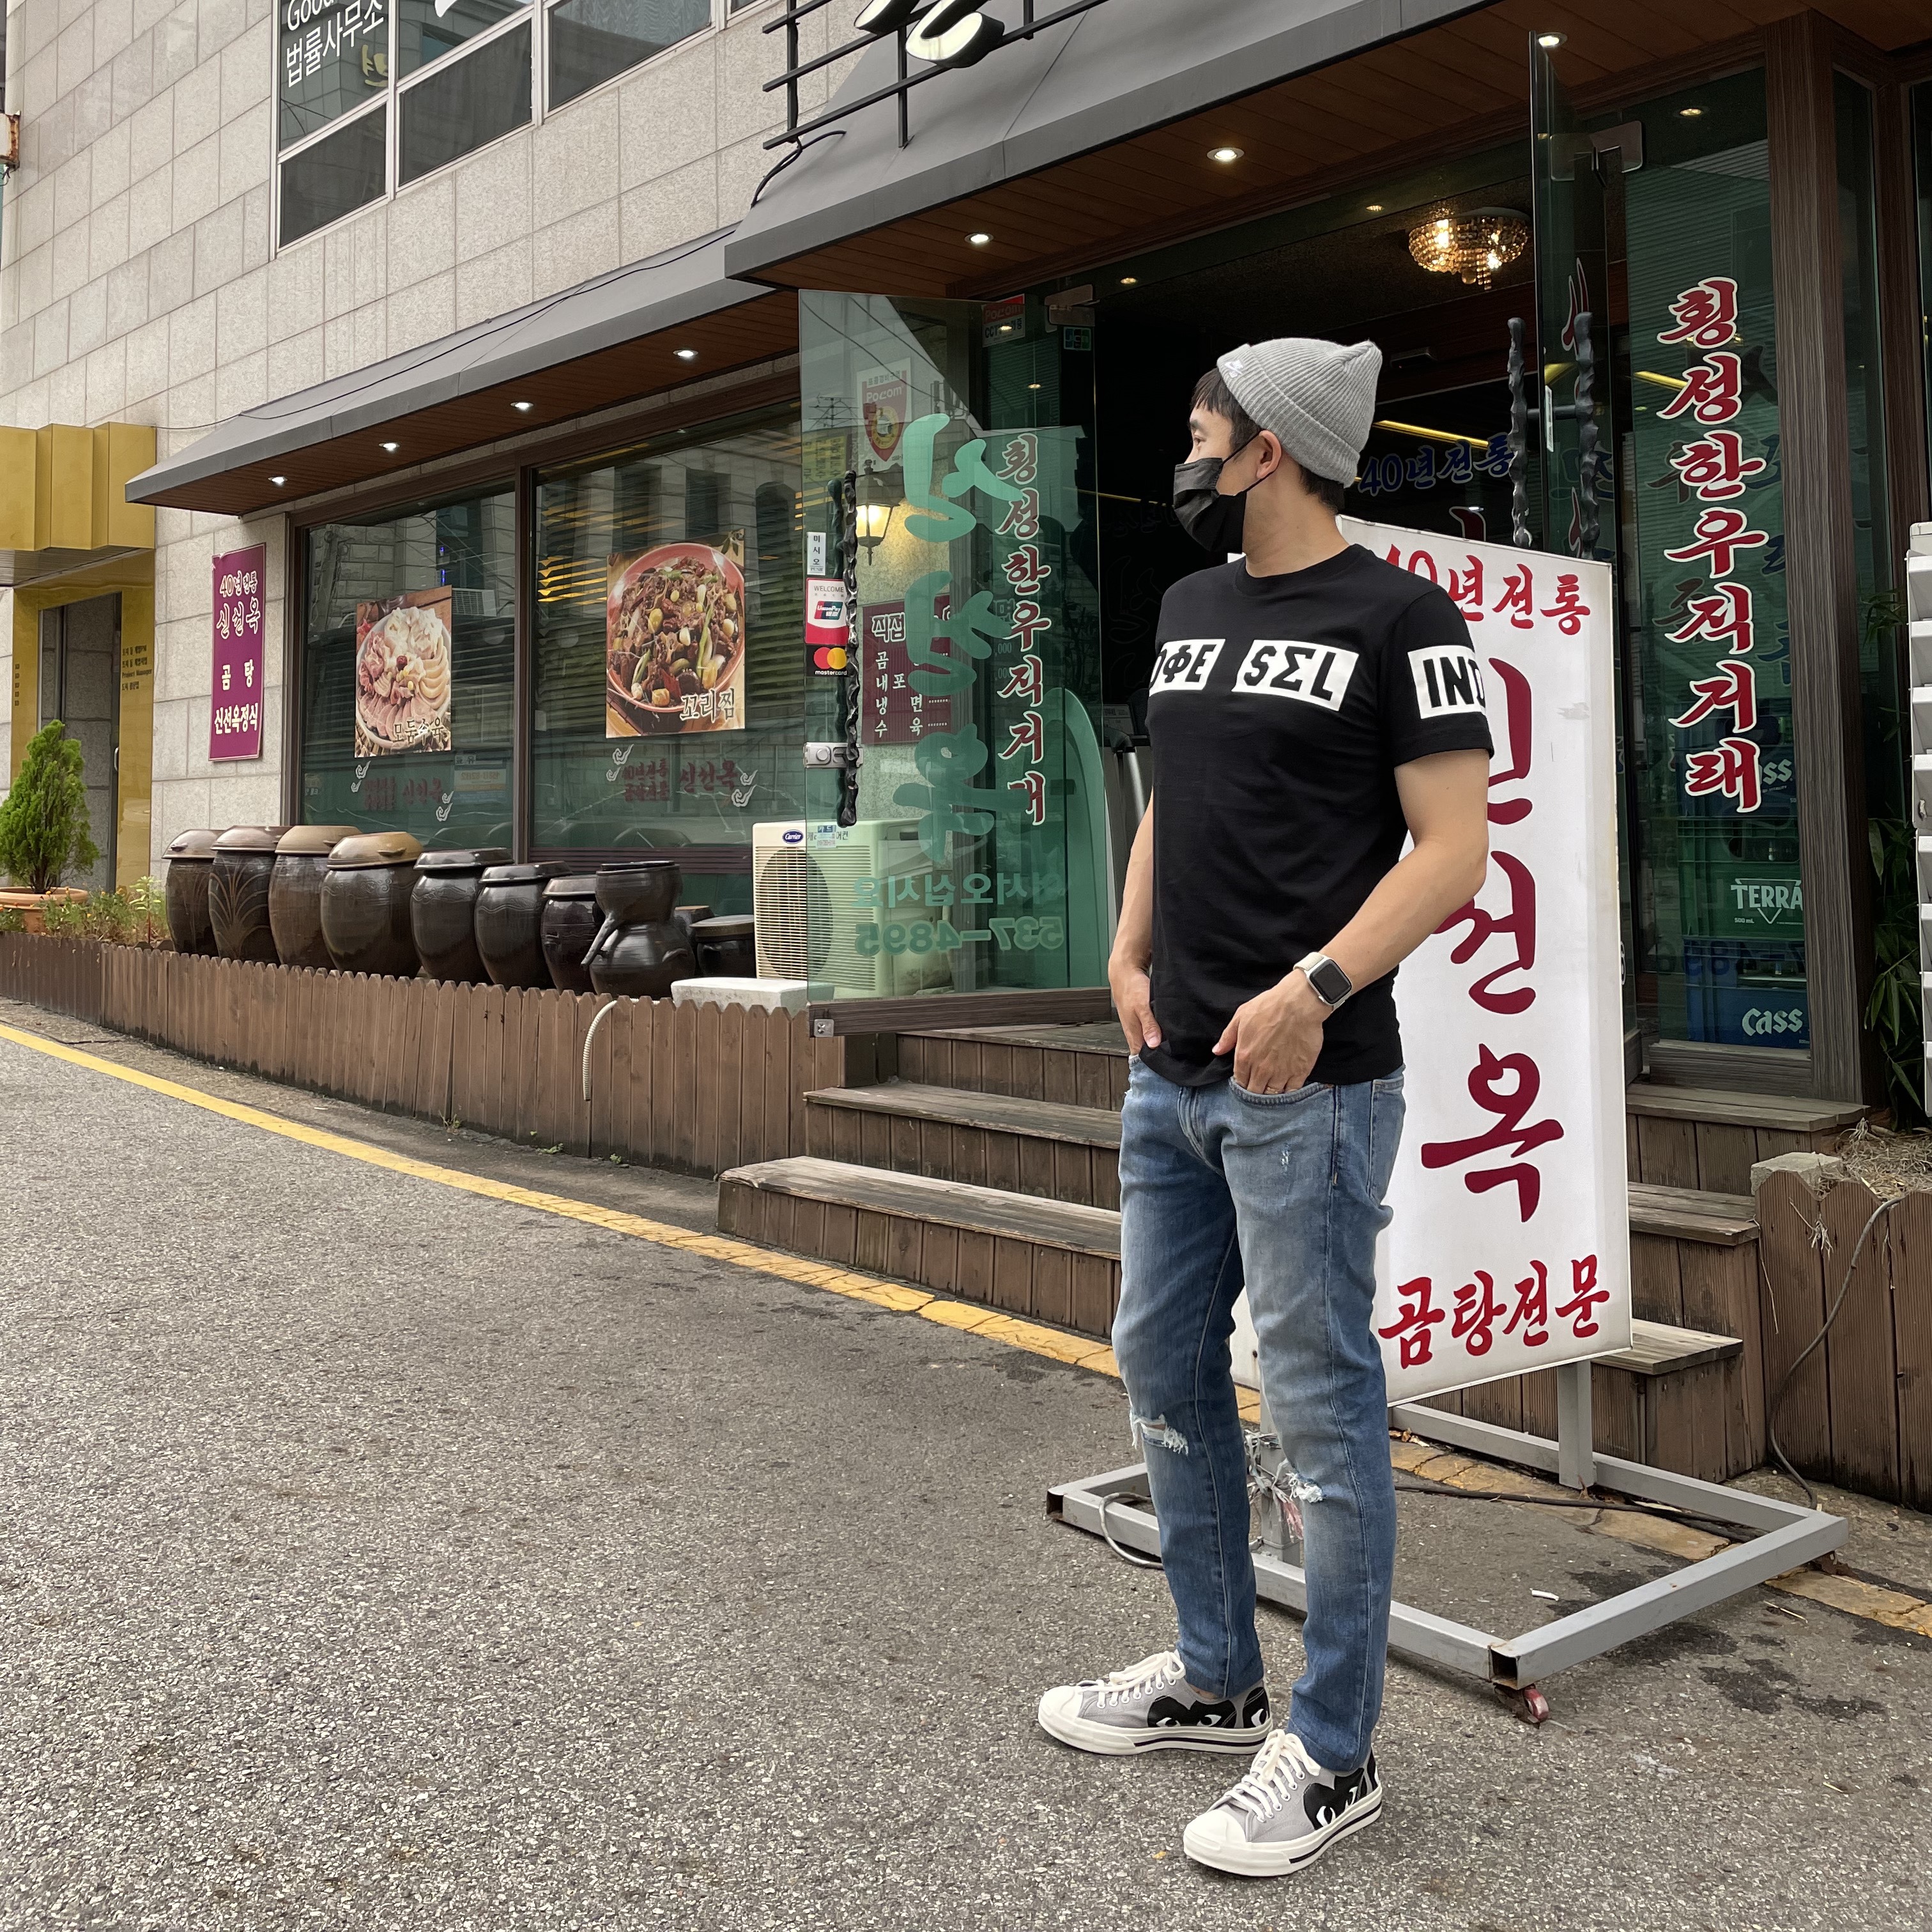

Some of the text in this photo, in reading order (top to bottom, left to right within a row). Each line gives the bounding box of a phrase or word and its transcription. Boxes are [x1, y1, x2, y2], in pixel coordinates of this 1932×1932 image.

[288, 0, 334, 31] Goo
[287, 0, 384, 88] 법률사무소
[1358, 432, 1515, 496] 40년전통
[1386, 544, 1591, 636] 0년전통
[214, 703, 259, 735] 신선옥정식
[680, 687, 735, 723] 꼬리찜
[392, 716, 444, 746] 모둠수육
[1730, 884, 1804, 911] TERRA
[1742, 1008, 1804, 1036] Cass
[1378, 1254, 1610, 1370] 곰탕전문
